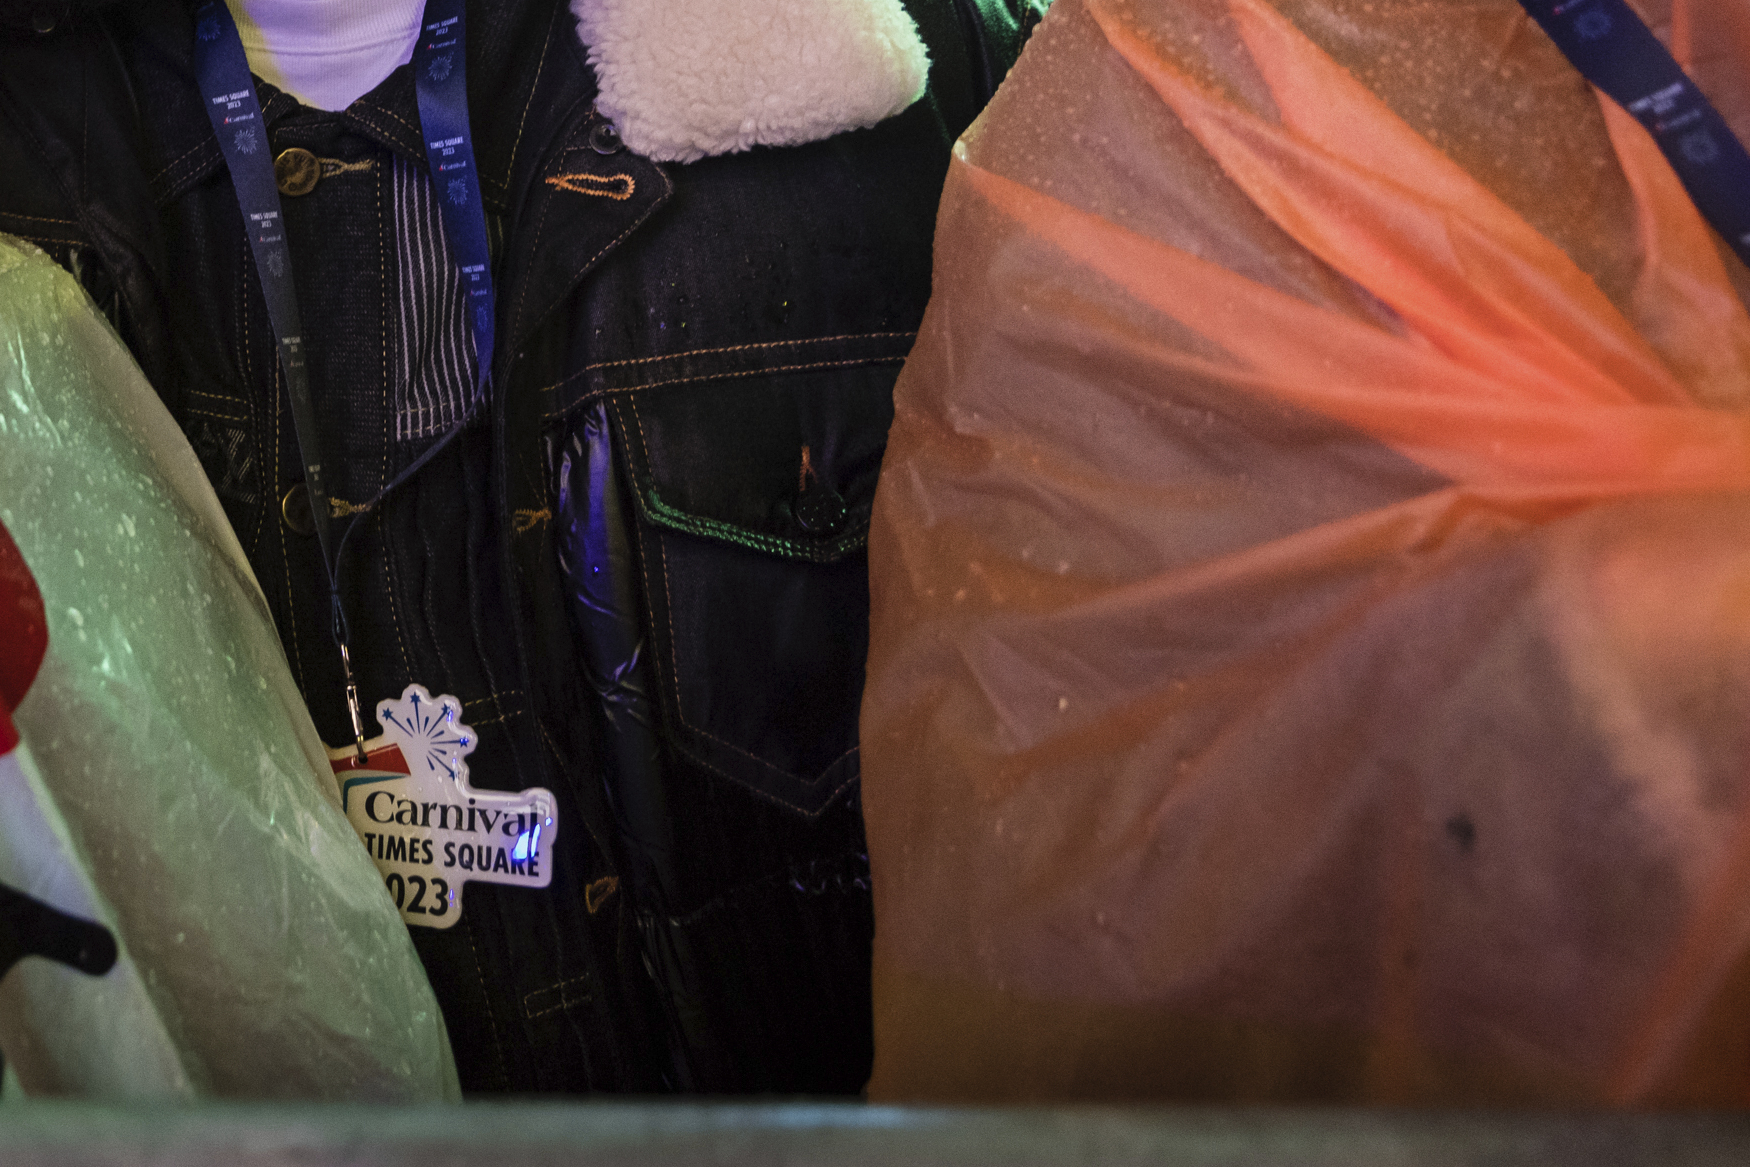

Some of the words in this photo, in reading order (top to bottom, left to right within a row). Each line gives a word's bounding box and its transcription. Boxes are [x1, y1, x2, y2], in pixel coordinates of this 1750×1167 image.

[365, 790, 538, 838] Carnival
[365, 832, 433, 865] TIMES
[443, 841, 540, 877] SQUARE
[385, 873, 449, 917] 023
